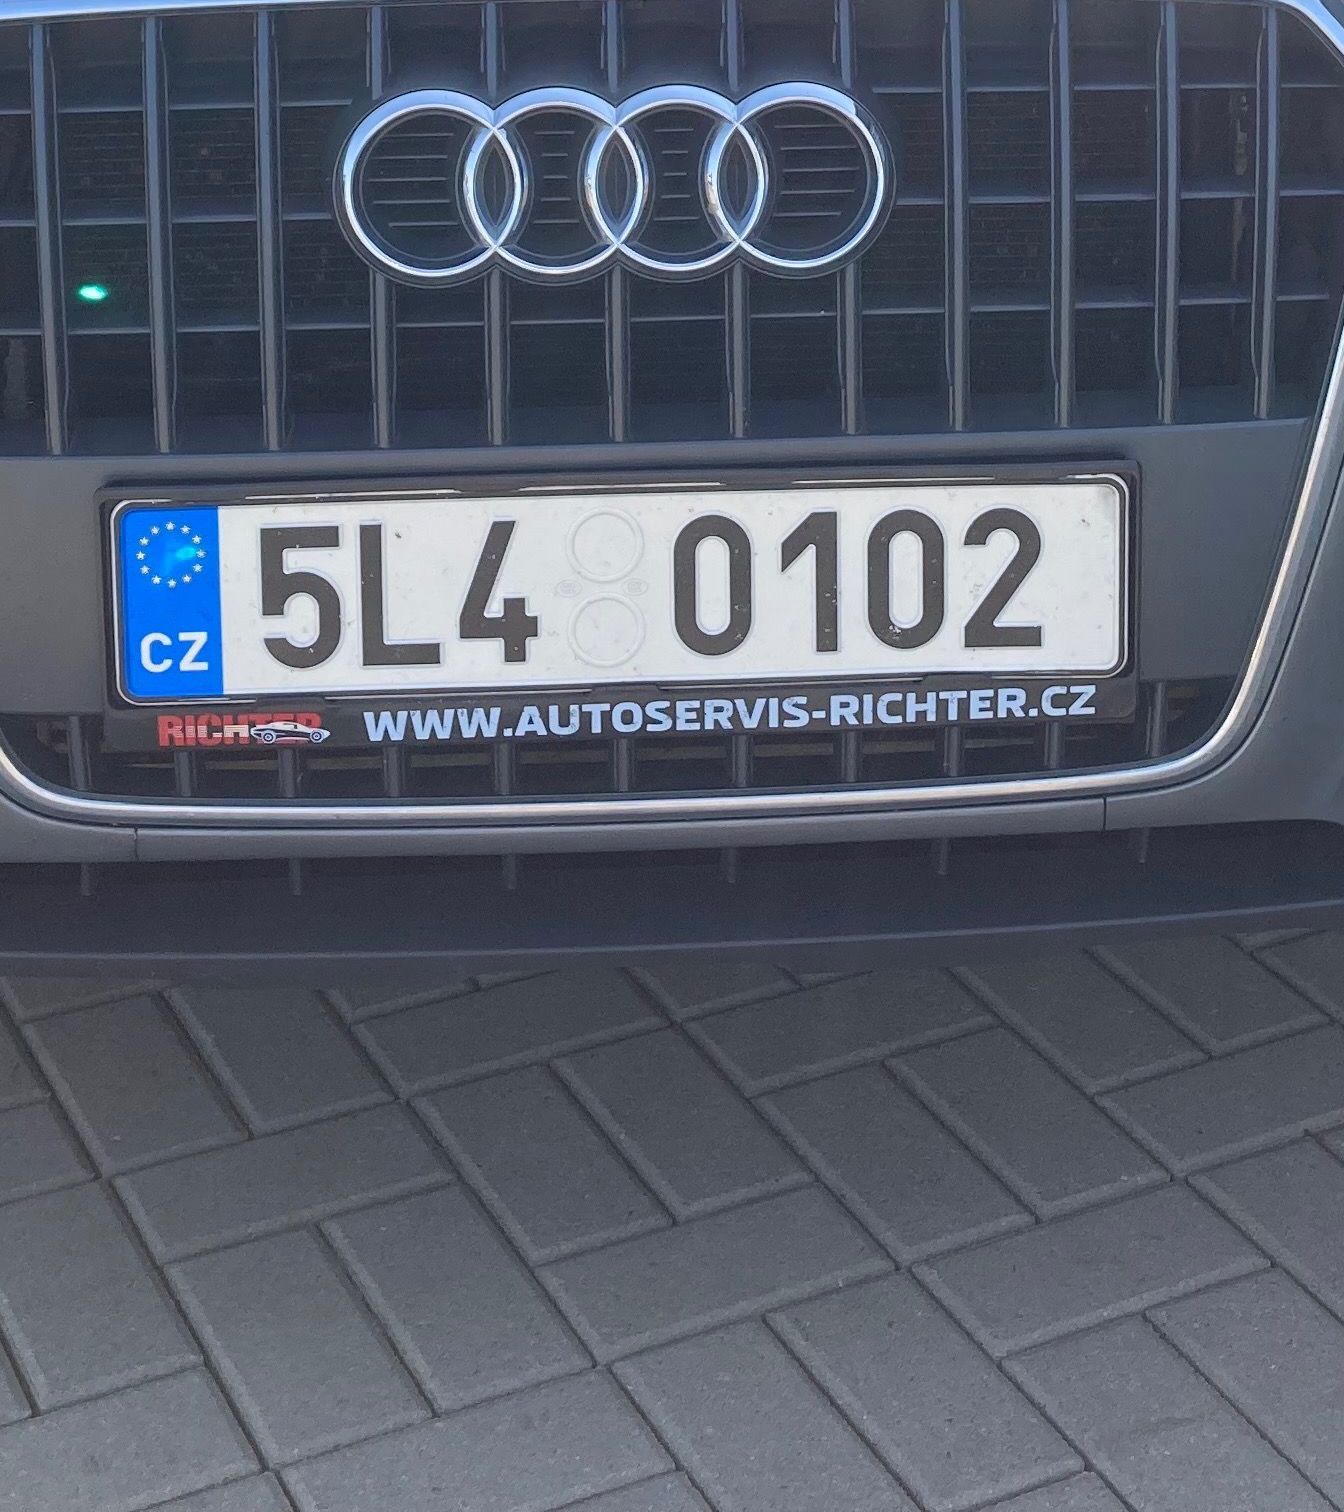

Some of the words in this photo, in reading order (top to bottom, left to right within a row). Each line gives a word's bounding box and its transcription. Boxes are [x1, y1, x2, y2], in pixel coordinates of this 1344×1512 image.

[260, 520, 539, 669] 5L4
[673, 507, 1042, 656] 0102
[140, 631, 209, 673] CZ
[362, 684, 1097, 742] WWW.AUTOSERVIS-RICHTER.CZ
